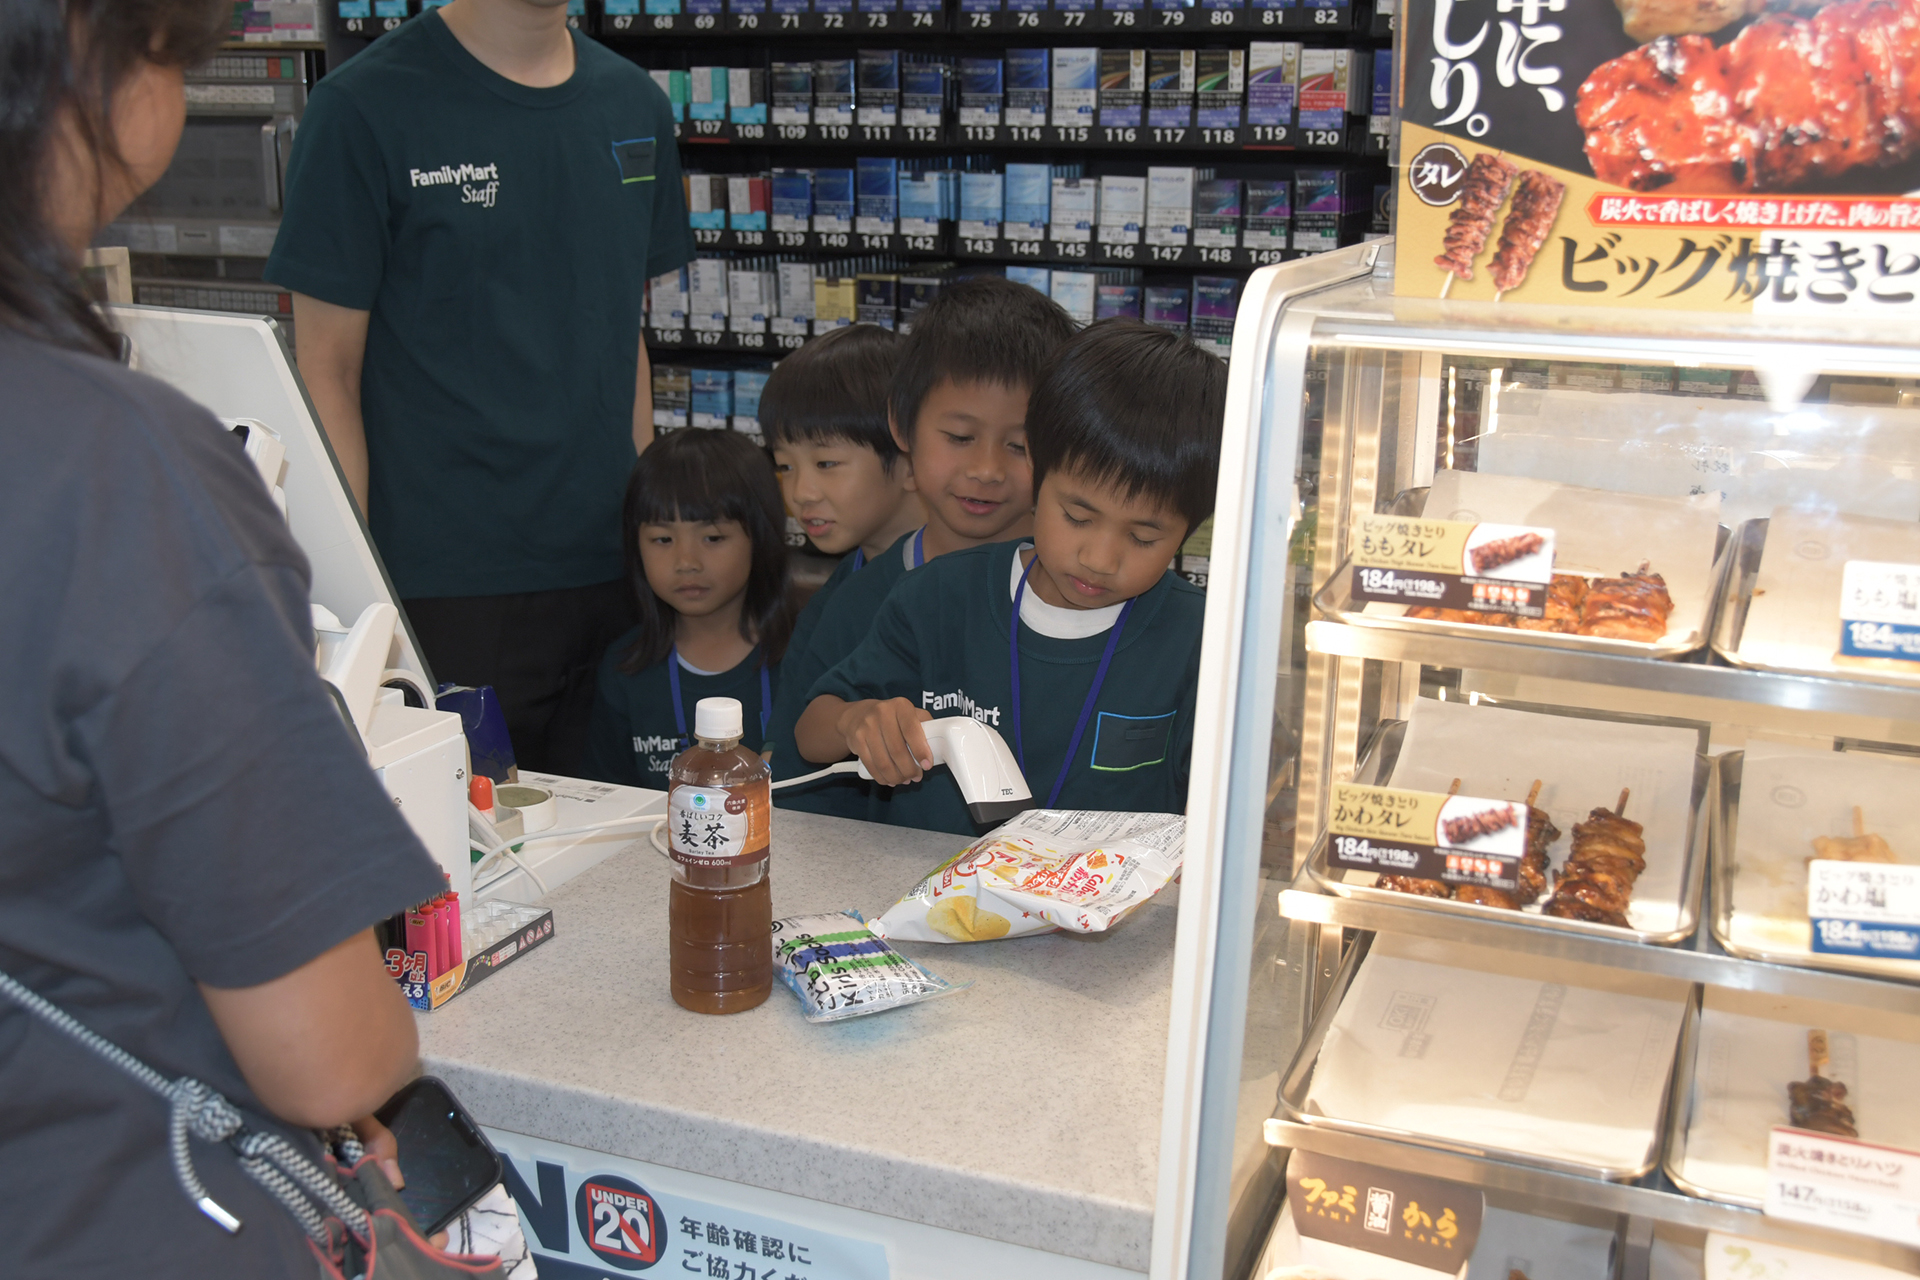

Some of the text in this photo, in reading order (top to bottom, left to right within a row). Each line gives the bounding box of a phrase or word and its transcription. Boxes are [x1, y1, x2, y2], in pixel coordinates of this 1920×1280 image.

[614, 15, 633, 29] 67
[653, 15, 674, 29] 68
[694, 14, 715, 29] 69
[738, 14, 759, 29] 70
[781, 14, 799, 29] 71
[823, 13, 844, 28] 72
[867, 13, 888, 28] 73
[912, 12, 933, 27] 74
[970, 13, 992, 28] 75
[1018, 12, 1039, 27] 76
[1063, 11, 1086, 27] 77
[1113, 11, 1135, 26] 78
[1162, 10, 1185, 26] 79
[1210, 10, 1234, 25] 80
[1262, 10, 1284, 25] 81
[1314, 9, 1338, 24] 82
[347, 18, 363, 32] 61
[694, 120, 722, 135] 107
[736, 125, 764, 139] 108
[778, 125, 806, 139] 109
[819, 126, 848, 140] 110
[863, 126, 892, 141] 111
[908, 127, 937, 141] 112
[966, 127, 995, 141] 113
[1011, 126, 1042, 141] 114
[1058, 127, 1088, 142] 115
[1105, 127, 1137, 143] 116
[1253, 126, 1287, 141] 119
[1153, 128, 1186, 143] 117
[1202, 129, 1235, 144] 118
[1305, 130, 1340, 146] 120
[410, 162, 498, 188] FamilyMart
[1417, 162, 1465, 188] タレ
[461, 183, 499, 208] Staff
[694, 229, 722, 243] 137
[735, 231, 763, 245] 138
[777, 232, 805, 246] 139
[819, 233, 848, 247] 140
[862, 235, 889, 249] 141
[905, 237, 934, 250] 142
[964, 239, 994, 254] 143
[1010, 241, 1041, 256] 144
[1056, 242, 1086, 257] 145
[1103, 244, 1135, 259] 146
[1151, 246, 1183, 261] 147
[1199, 248, 1232, 263] 148
[1249, 250, 1282, 264] 149
[1560, 231, 1920, 304] ビッグ焼きと
[655, 329, 682, 343] 166
[695, 332, 722, 345] 167
[736, 333, 764, 347] 168
[777, 335, 805, 348] 169
[785, 533, 806, 547] 29
[1361, 535, 1437, 558] ももタレ
[1187, 573, 1208, 587] 23
[922, 689, 1000, 726] FamilyMart
[632, 735, 682, 754] ilyMar
[648, 752, 681, 777] Sta
[1001, 788, 1013, 796] TEC
[680, 810, 723, 821] 香ばしいコク
[1335, 804, 1413, 828] かわタレ
[679, 819, 730, 850] 麦茶
[688, 848, 704, 856] Barley
[711, 858, 732, 867] 600ml
[796, 933, 863, 1007] Kids Socks
[591, 1188, 649, 1213] UNDER
[1299, 1177, 1358, 1215] ファミ
[1306, 1204, 1350, 1223] FAMI
[1402, 1201, 1459, 1239] から
[594, 1202, 650, 1255] 20
[680, 1216, 812, 1265] 年齢確認に
[1404, 1229, 1453, 1249] KARA
